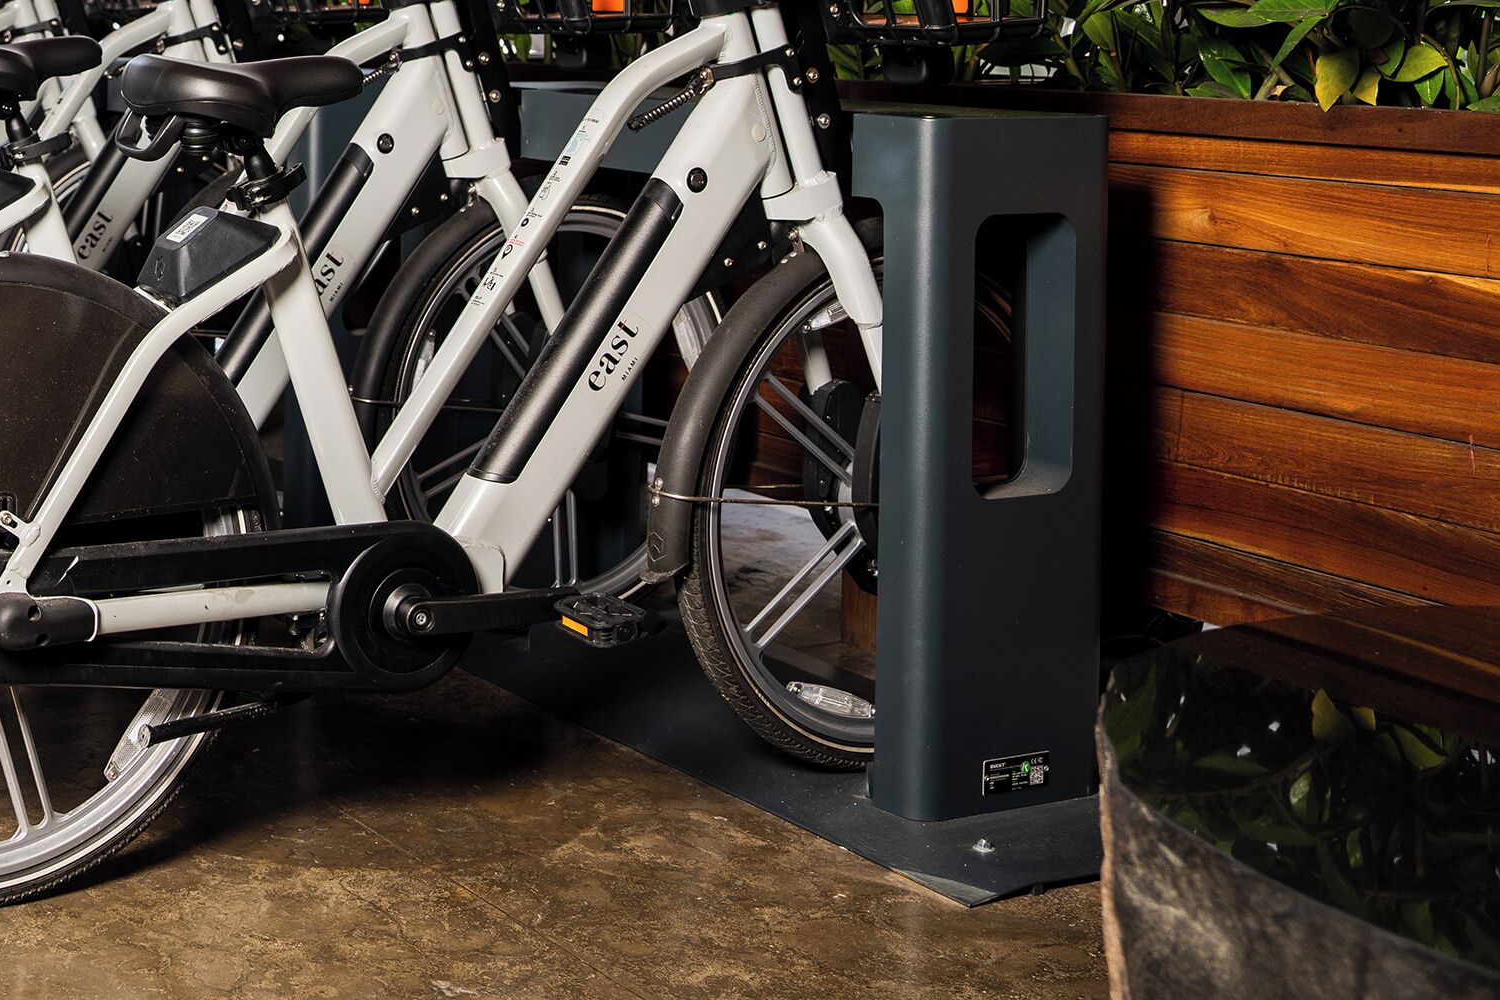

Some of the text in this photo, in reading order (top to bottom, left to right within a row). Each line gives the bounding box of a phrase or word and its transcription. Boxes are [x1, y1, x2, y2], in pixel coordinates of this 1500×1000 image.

[77, 211, 113, 260] east
[314, 251, 344, 297] ast
[588, 319, 639, 392] east
[621, 357, 638, 381] MIAMI
